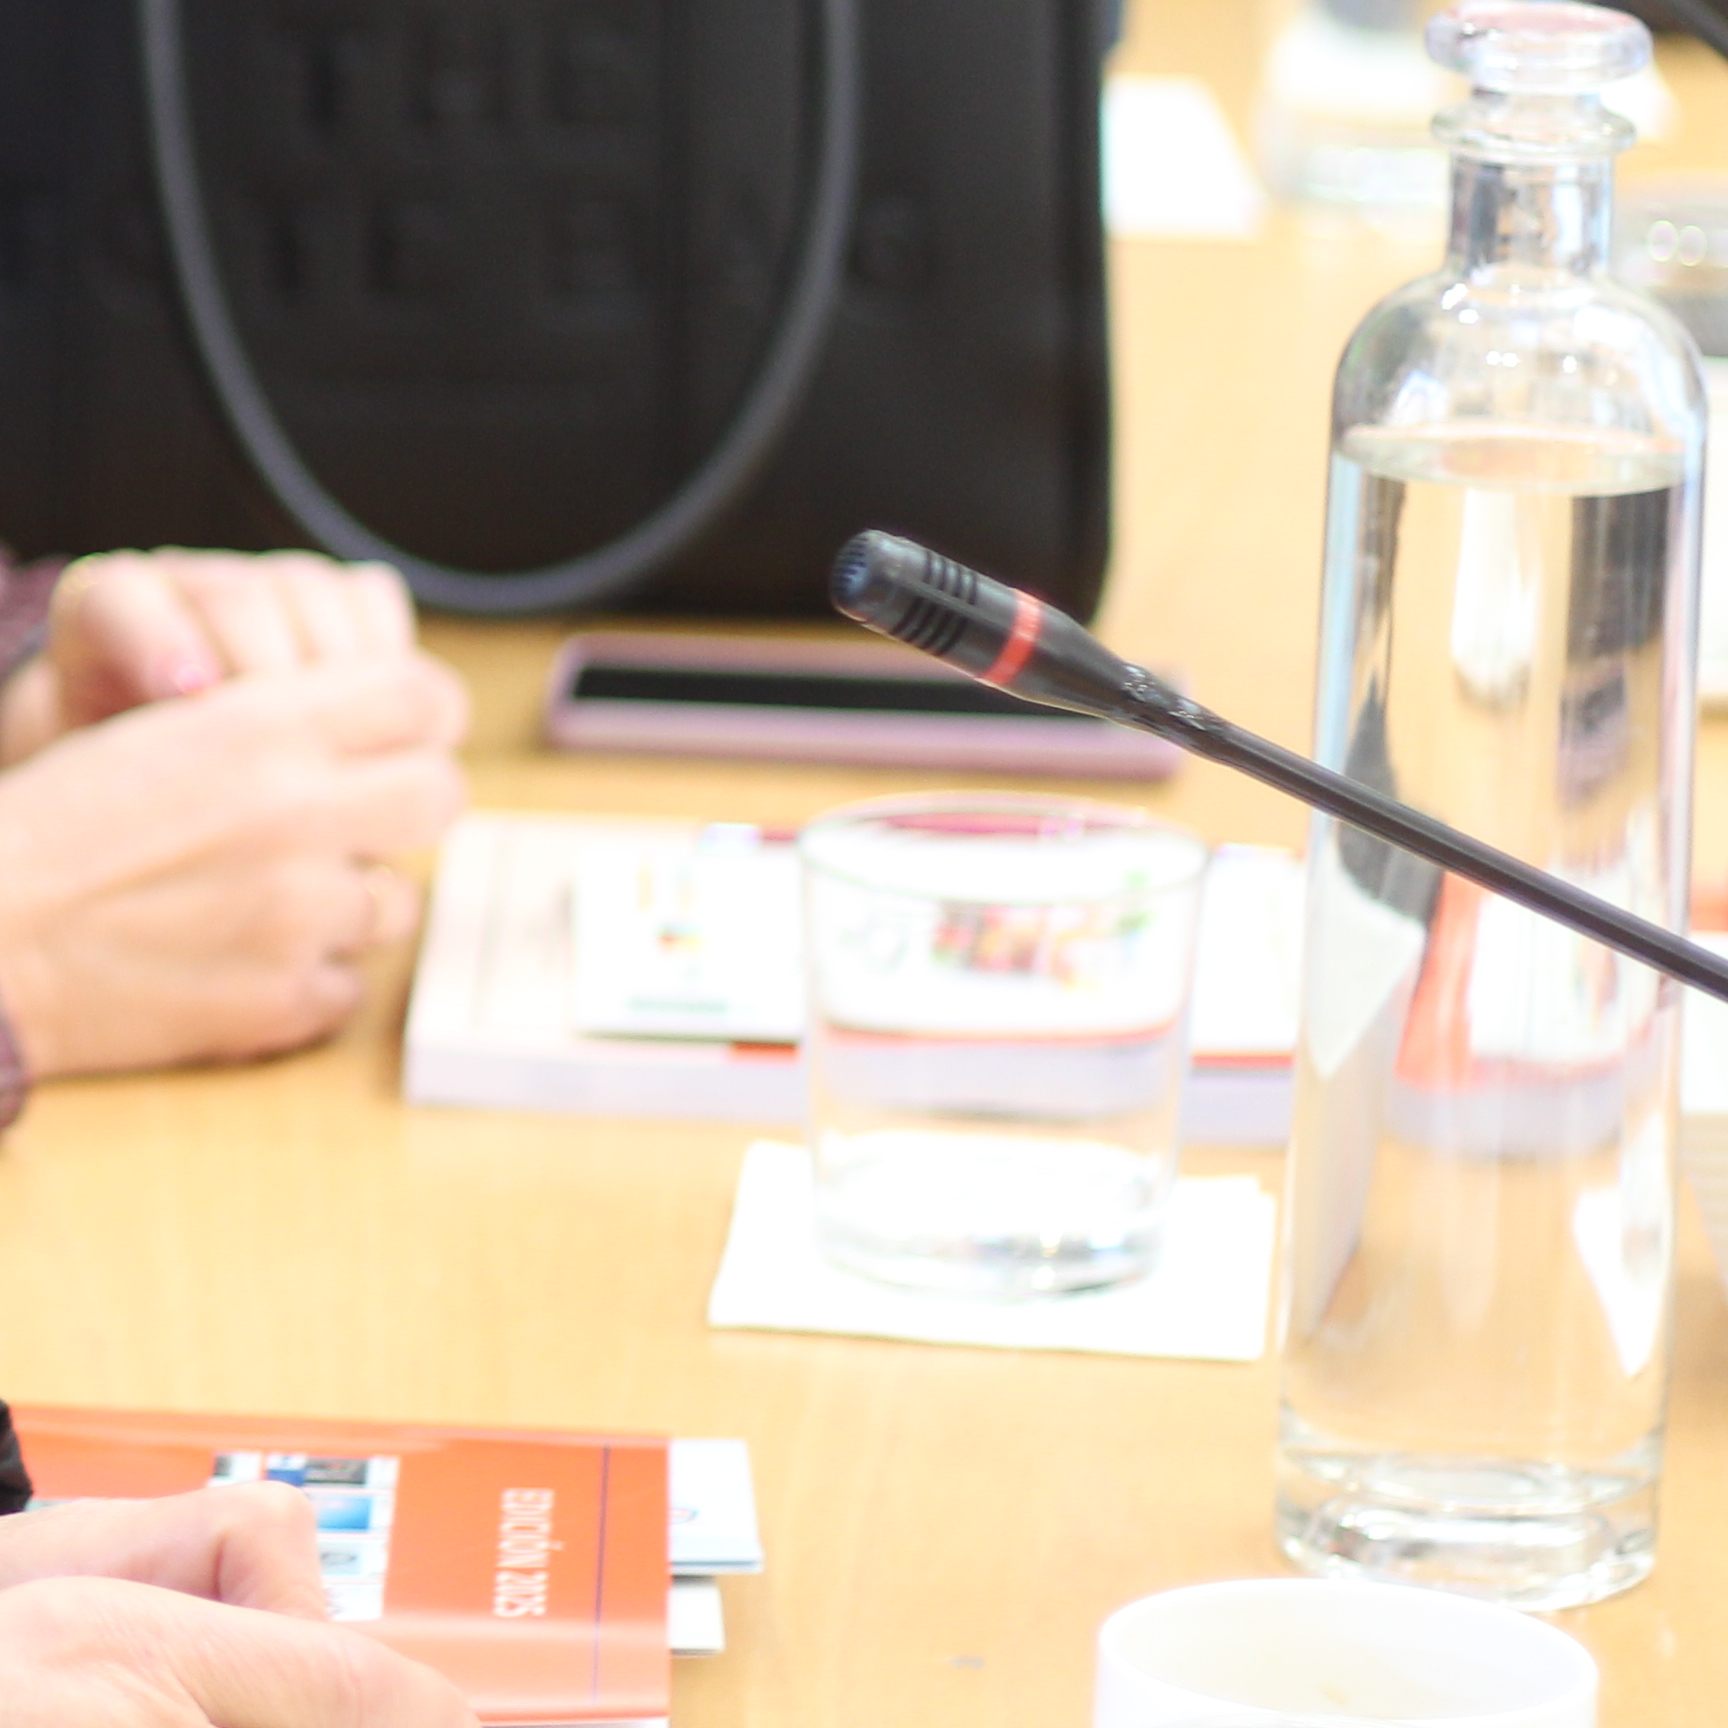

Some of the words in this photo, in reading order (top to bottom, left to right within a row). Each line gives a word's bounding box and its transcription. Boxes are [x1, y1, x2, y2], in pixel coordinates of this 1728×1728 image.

[262, 6, 634, 132] THE
[495, 1487, 565, 1568] EDICIÓN
[493, 1570, 548, 1617] 2025
